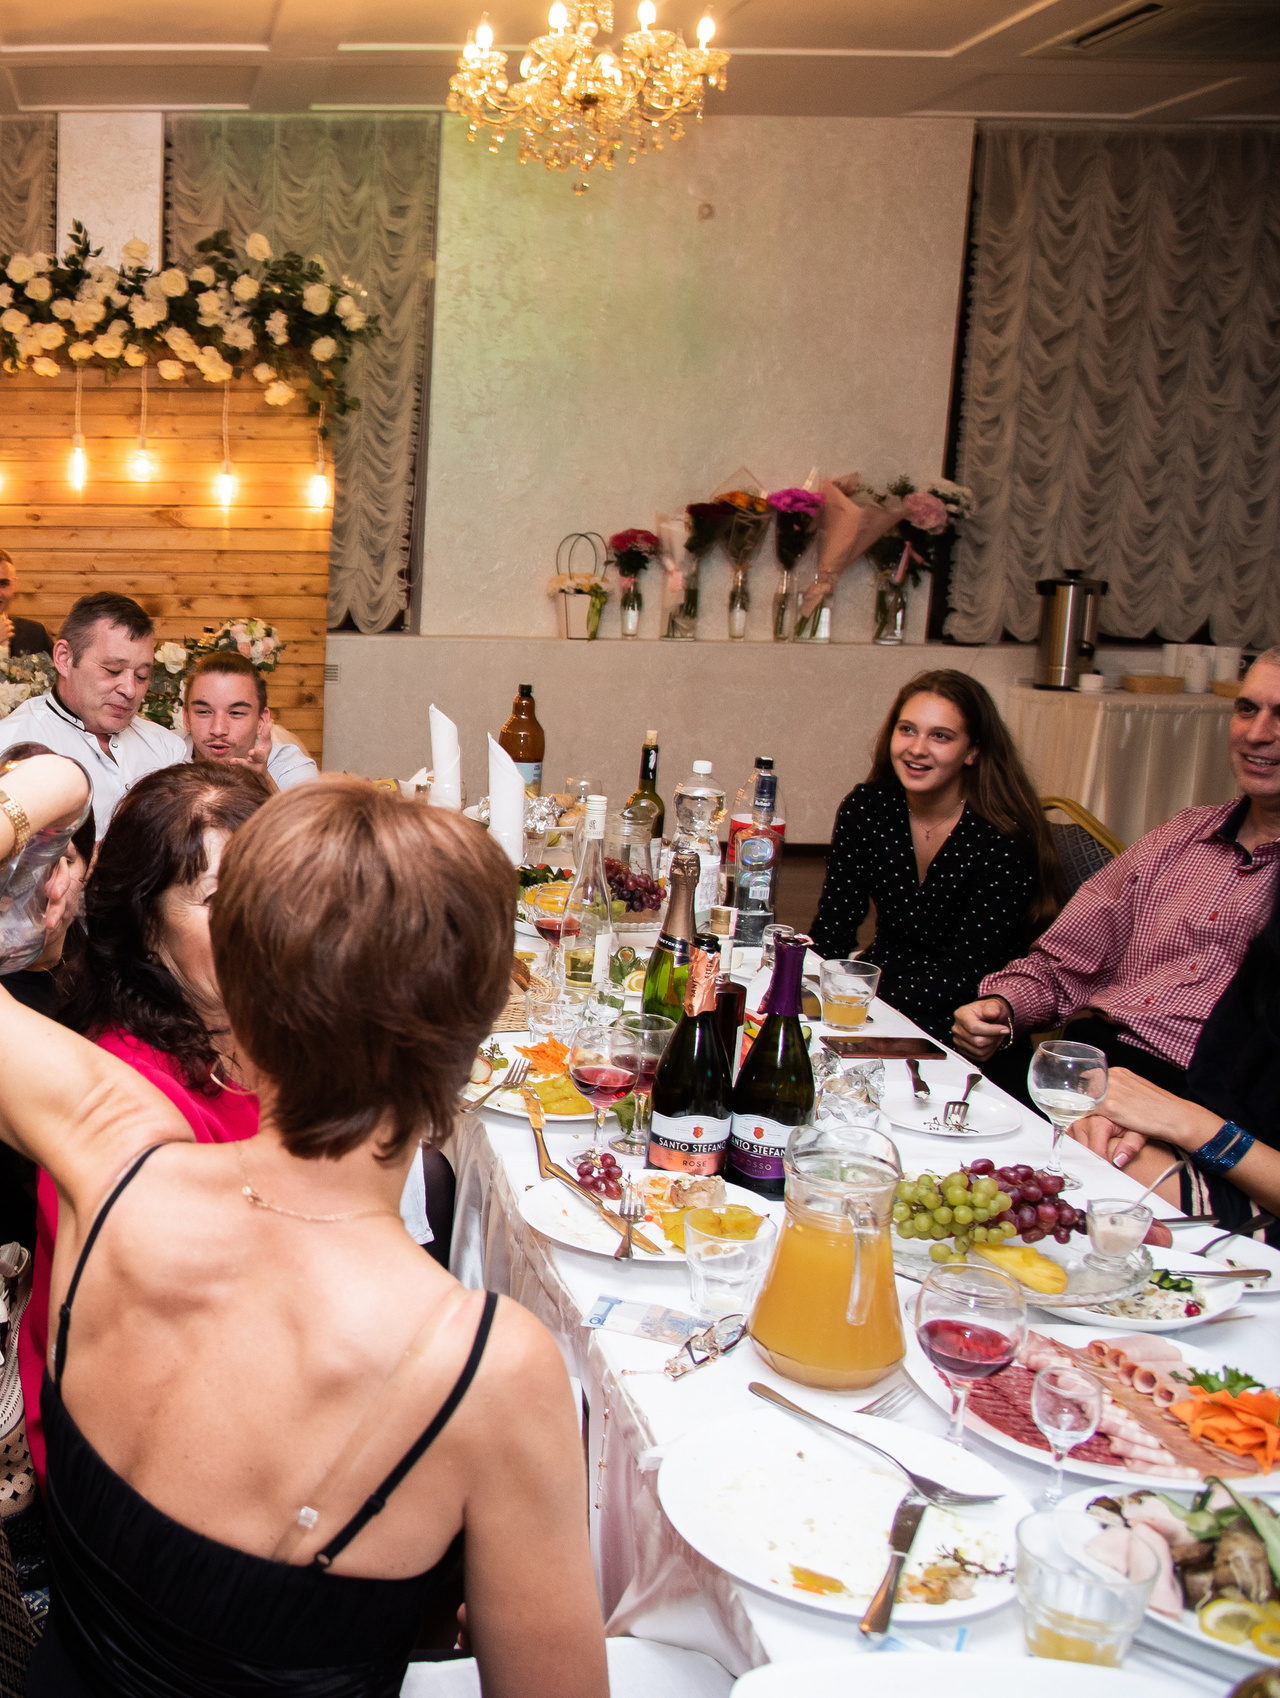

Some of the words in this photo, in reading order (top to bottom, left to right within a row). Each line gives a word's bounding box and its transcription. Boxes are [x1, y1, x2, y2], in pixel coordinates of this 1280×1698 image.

[659, 1137, 689, 1152] SANTO
[692, 1140, 727, 1153] STEFANO
[731, 1136, 750, 1150] ANTO
[752, 1144, 786, 1157] STEFAN
